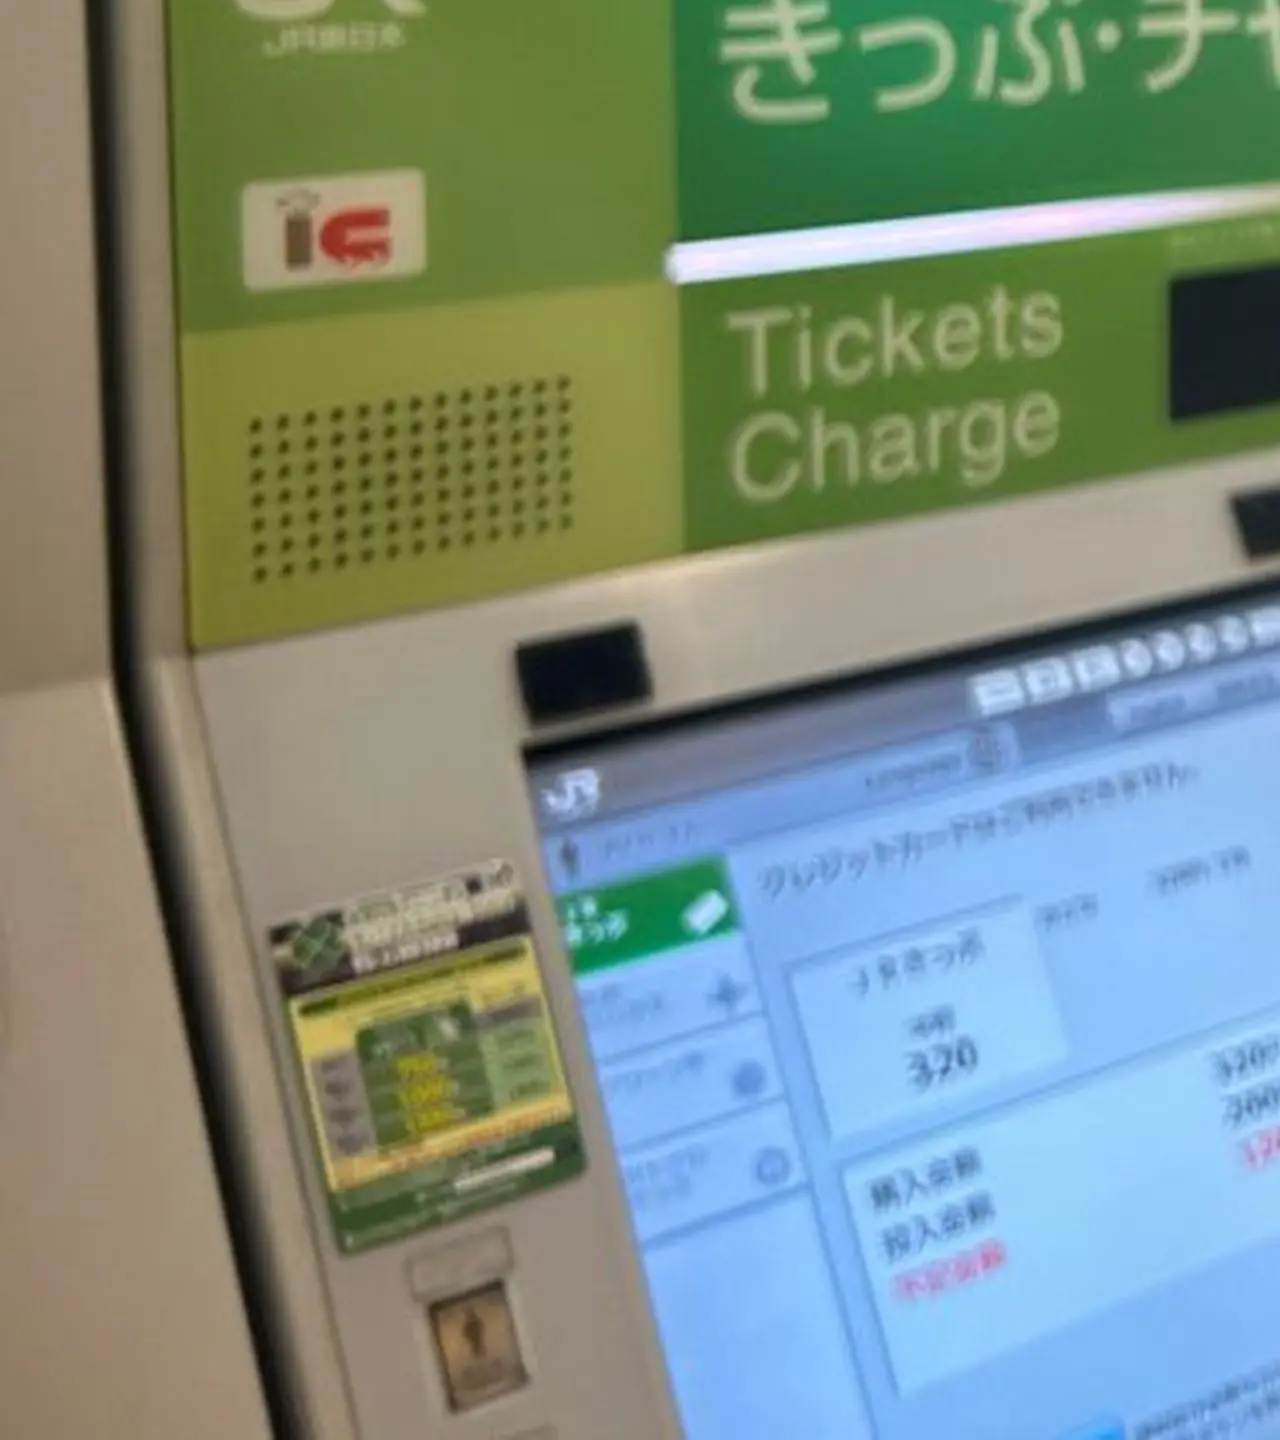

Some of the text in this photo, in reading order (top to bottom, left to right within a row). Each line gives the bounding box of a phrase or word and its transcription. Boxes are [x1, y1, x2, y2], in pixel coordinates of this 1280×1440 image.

[726, 283, 1065, 398] Tickets
[729, 390, 1062, 503] Charge
[903, 1034, 981, 1093] 320
